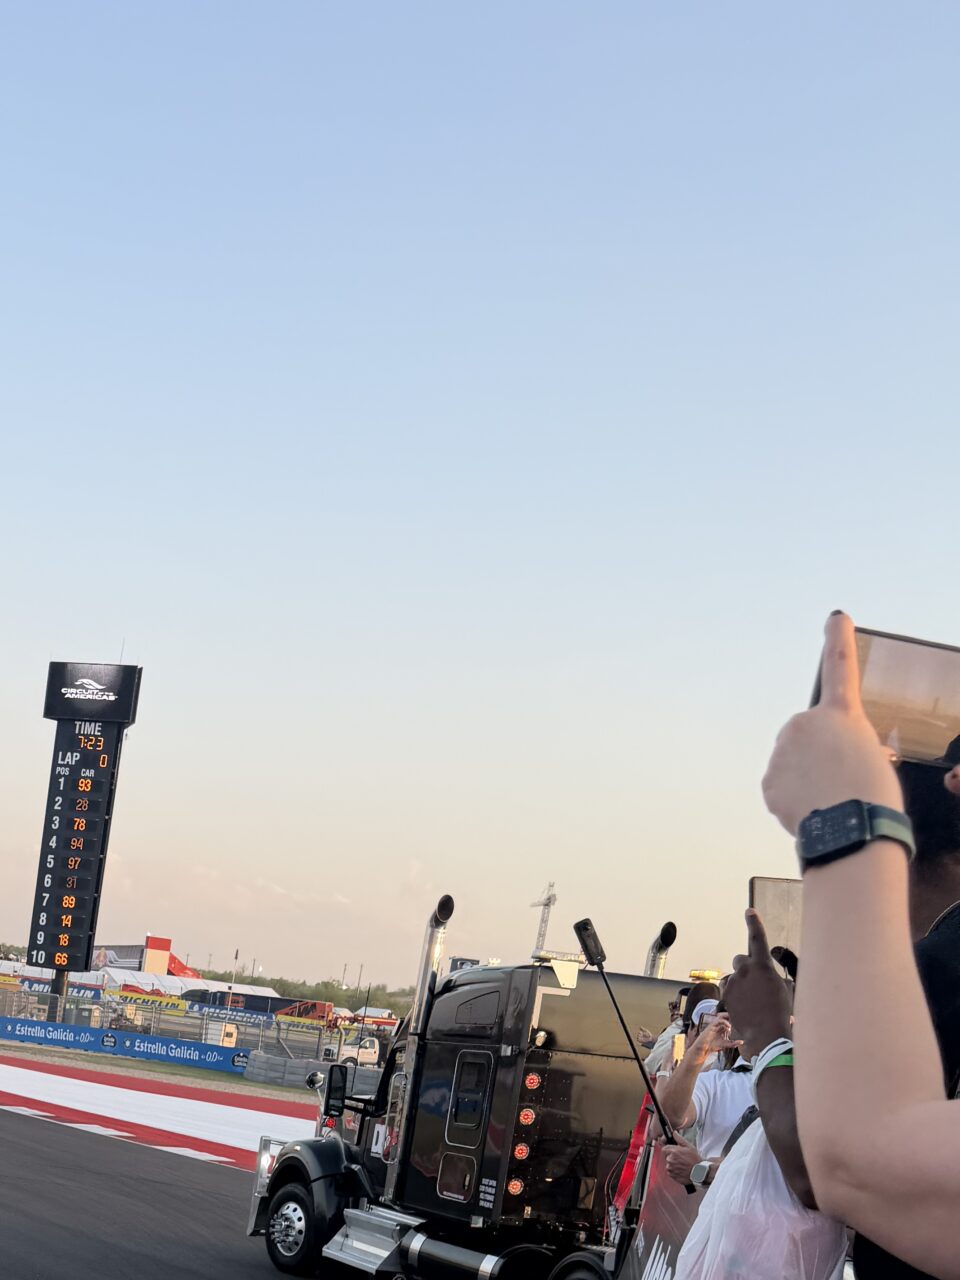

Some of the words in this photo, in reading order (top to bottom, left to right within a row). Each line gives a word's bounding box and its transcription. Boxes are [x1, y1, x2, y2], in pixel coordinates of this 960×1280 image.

[74, 721, 102, 735] TIME
[78, 736, 104, 750] 7:23
[58, 752, 80, 765] LAP
[99, 754, 108, 768] 0
[56, 766, 70, 776] POS
[81, 768, 94, 777] CAR
[58, 777, 65, 790] 1
[78, 779, 92, 791] 93
[54, 797, 62, 810] 2
[52, 816, 60, 830] 3
[73, 818, 86, 831] 78
[49, 836, 57, 849] 4
[70, 838, 84, 850] 94
[46, 855, 54, 868] 5
[68, 857, 81, 870] 97
[44, 874, 52, 888] 6
[42, 893, 50, 906] 7
[62, 896, 76, 909] 89
[39, 912, 46, 926] 8
[61, 915, 72, 928] 14
[37, 931, 44, 945] 9
[58, 934, 69, 947] 18
[31, 950, 46, 964] 10
[54, 952, 68, 966] 66
[15, 1023, 45, 1038] Estrella
[46, 1026, 74, 1041] Galicia
[134, 1039, 166, 1055] Estrella
[168, 1044, 199, 1061] Galicia
